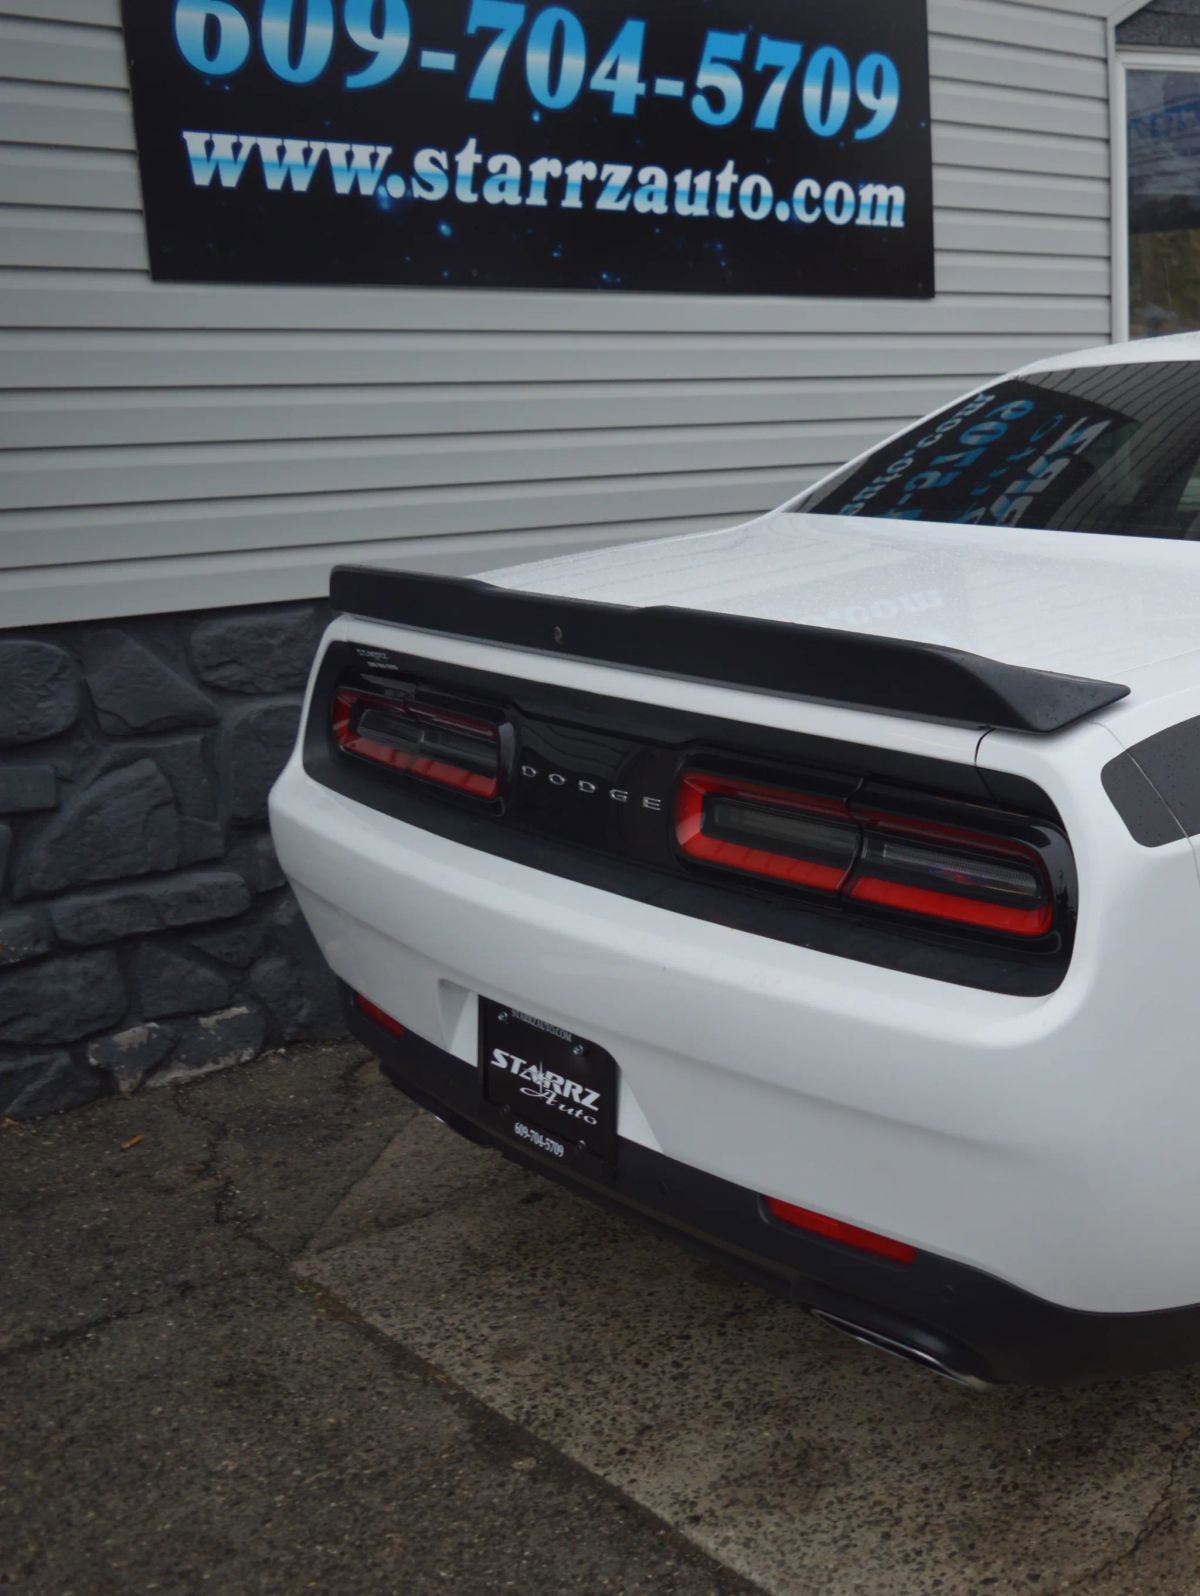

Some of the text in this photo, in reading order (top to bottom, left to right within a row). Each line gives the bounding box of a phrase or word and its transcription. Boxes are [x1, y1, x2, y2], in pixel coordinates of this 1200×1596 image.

[173, 0, 901, 141] 609-704-5709
[181, 129, 906, 229] www.starrzauto.com
[521, 765, 662, 811] DODGE
[490, 1048, 601, 1111] STARRZ
[520, 1088, 598, 1126] Auto
[514, 1121, 565, 1158] 609-704-5709
